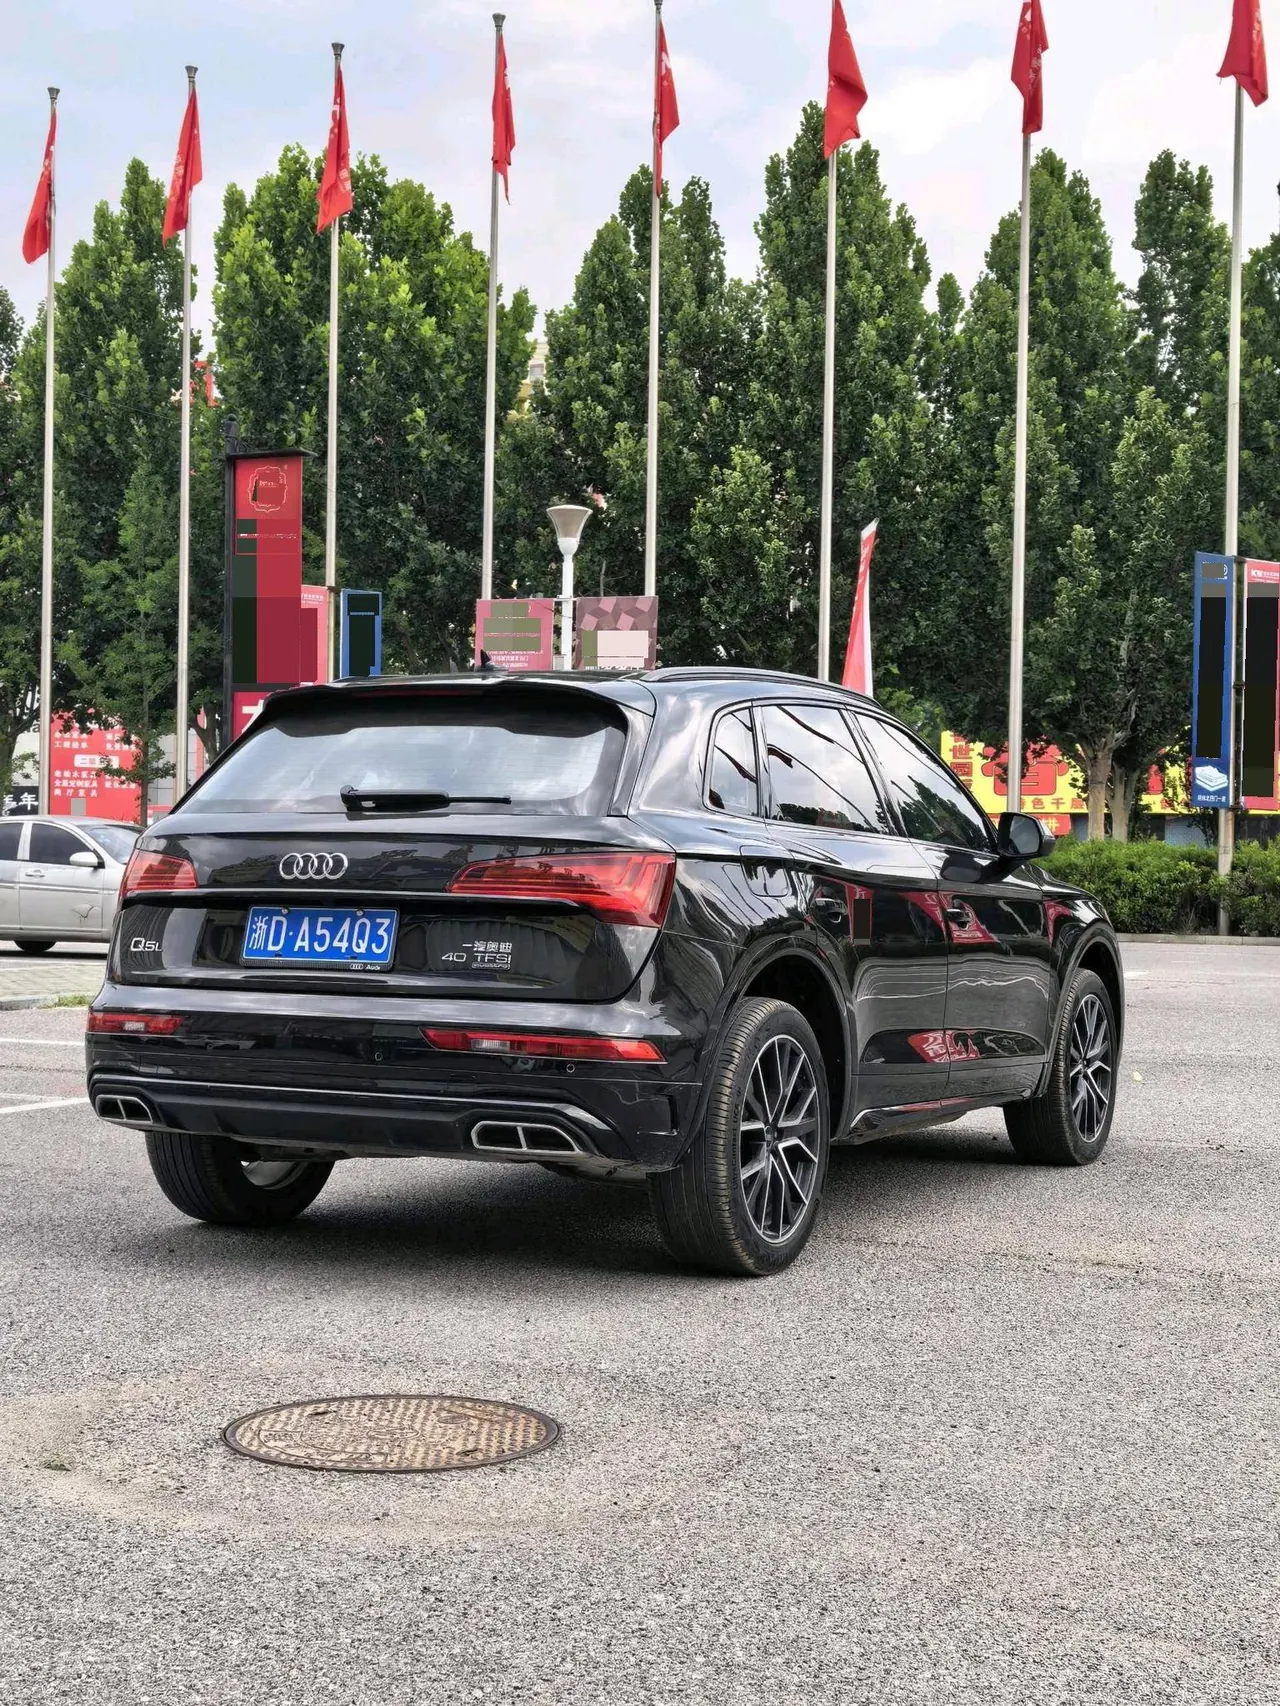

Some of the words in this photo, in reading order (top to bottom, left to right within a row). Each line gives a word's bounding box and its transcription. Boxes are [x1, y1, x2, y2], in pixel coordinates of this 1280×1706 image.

[130, 937, 162, 952] Q5L
[462, 940, 513, 953] 一汽奥迪
[441, 952, 467, 962] 40
[474, 953, 512, 964] TFSI
